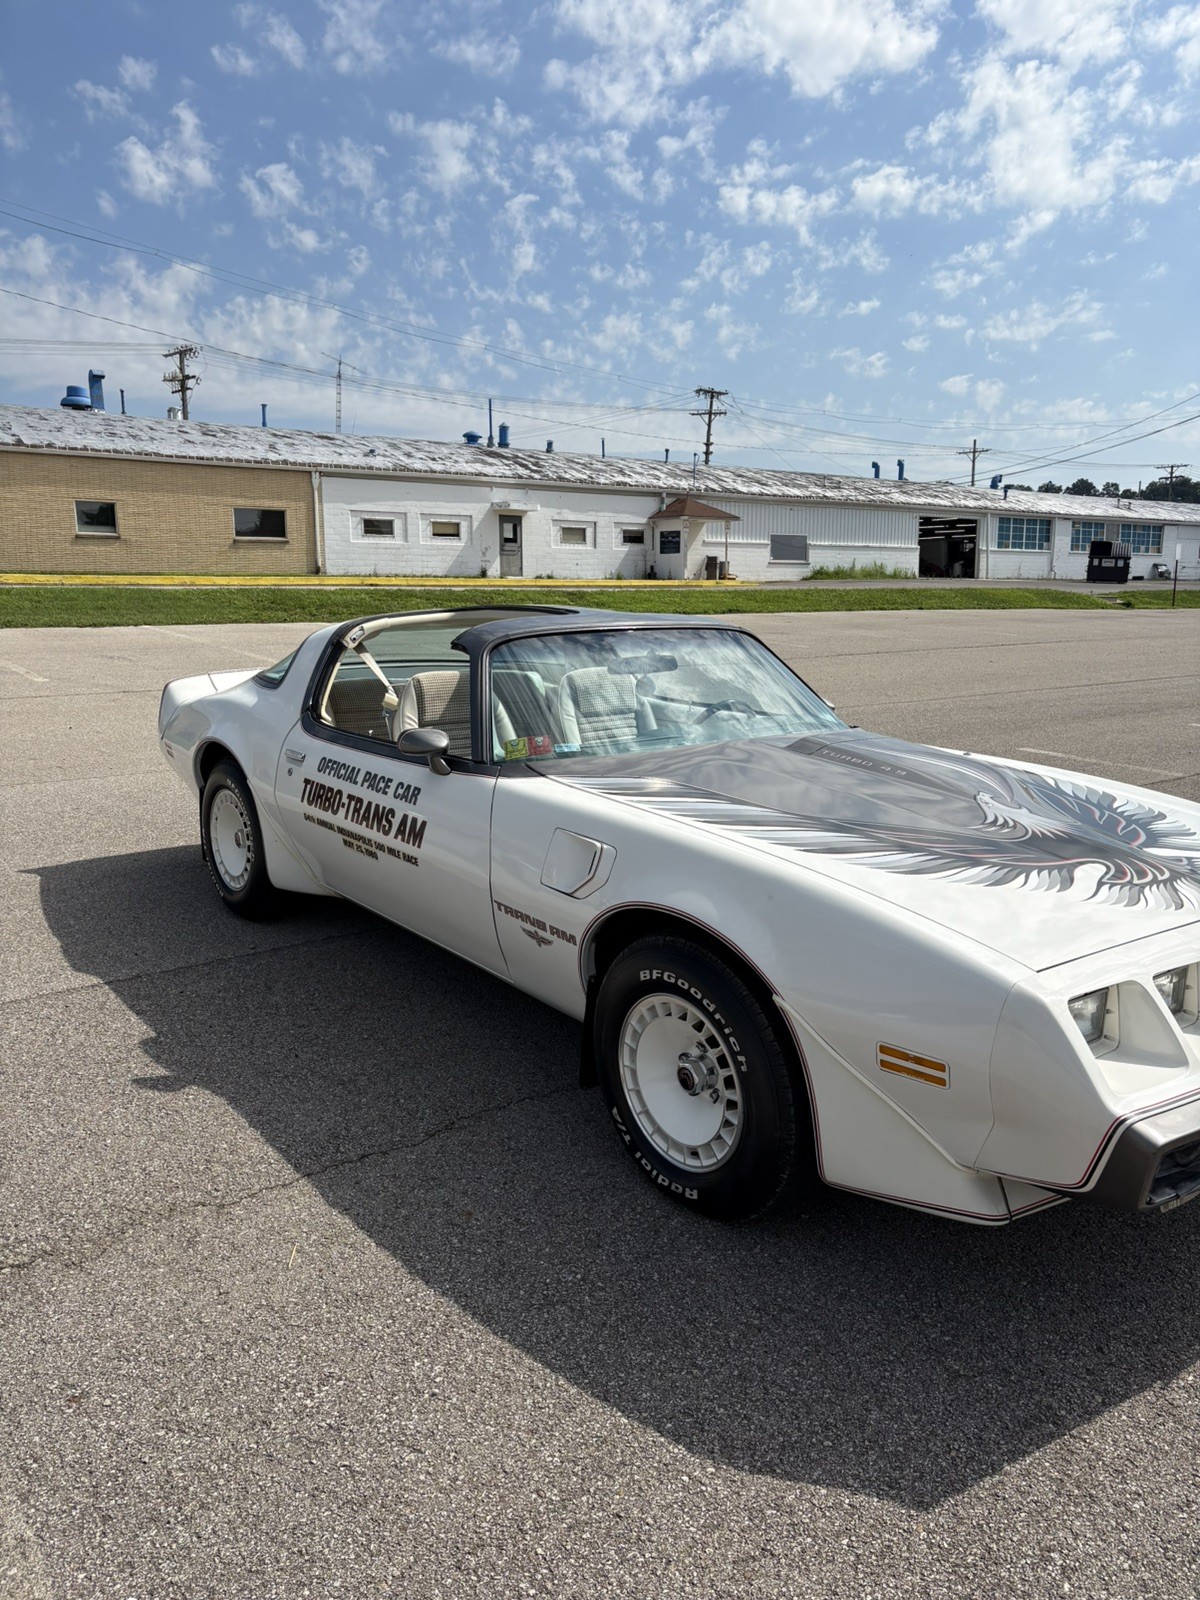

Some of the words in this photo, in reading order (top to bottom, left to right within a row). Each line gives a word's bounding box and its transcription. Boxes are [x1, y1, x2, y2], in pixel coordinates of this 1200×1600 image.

[317, 756, 361, 785] OFFICIAL
[361, 771, 393, 795] PACE
[393, 781, 421, 805] CAR
[823, 750, 873, 767] TURBO
[316, 817, 337, 832] ANNUAL
[336, 825, 374, 848] INDIANAPOLIS
[373, 840, 386, 853] 500
[386, 846, 402, 860] MILE
[402, 852, 419, 867] RACE
[342, 837, 355, 850] MAY
[394, 813, 427, 849] AM
[493, 900, 548, 933] TRANS
[549, 924, 577, 946] AM
[640, 969, 748, 1072] BFGoodrich
[612, 1106, 631, 1145] T/A
[635, 1151, 698, 1200] Radial
